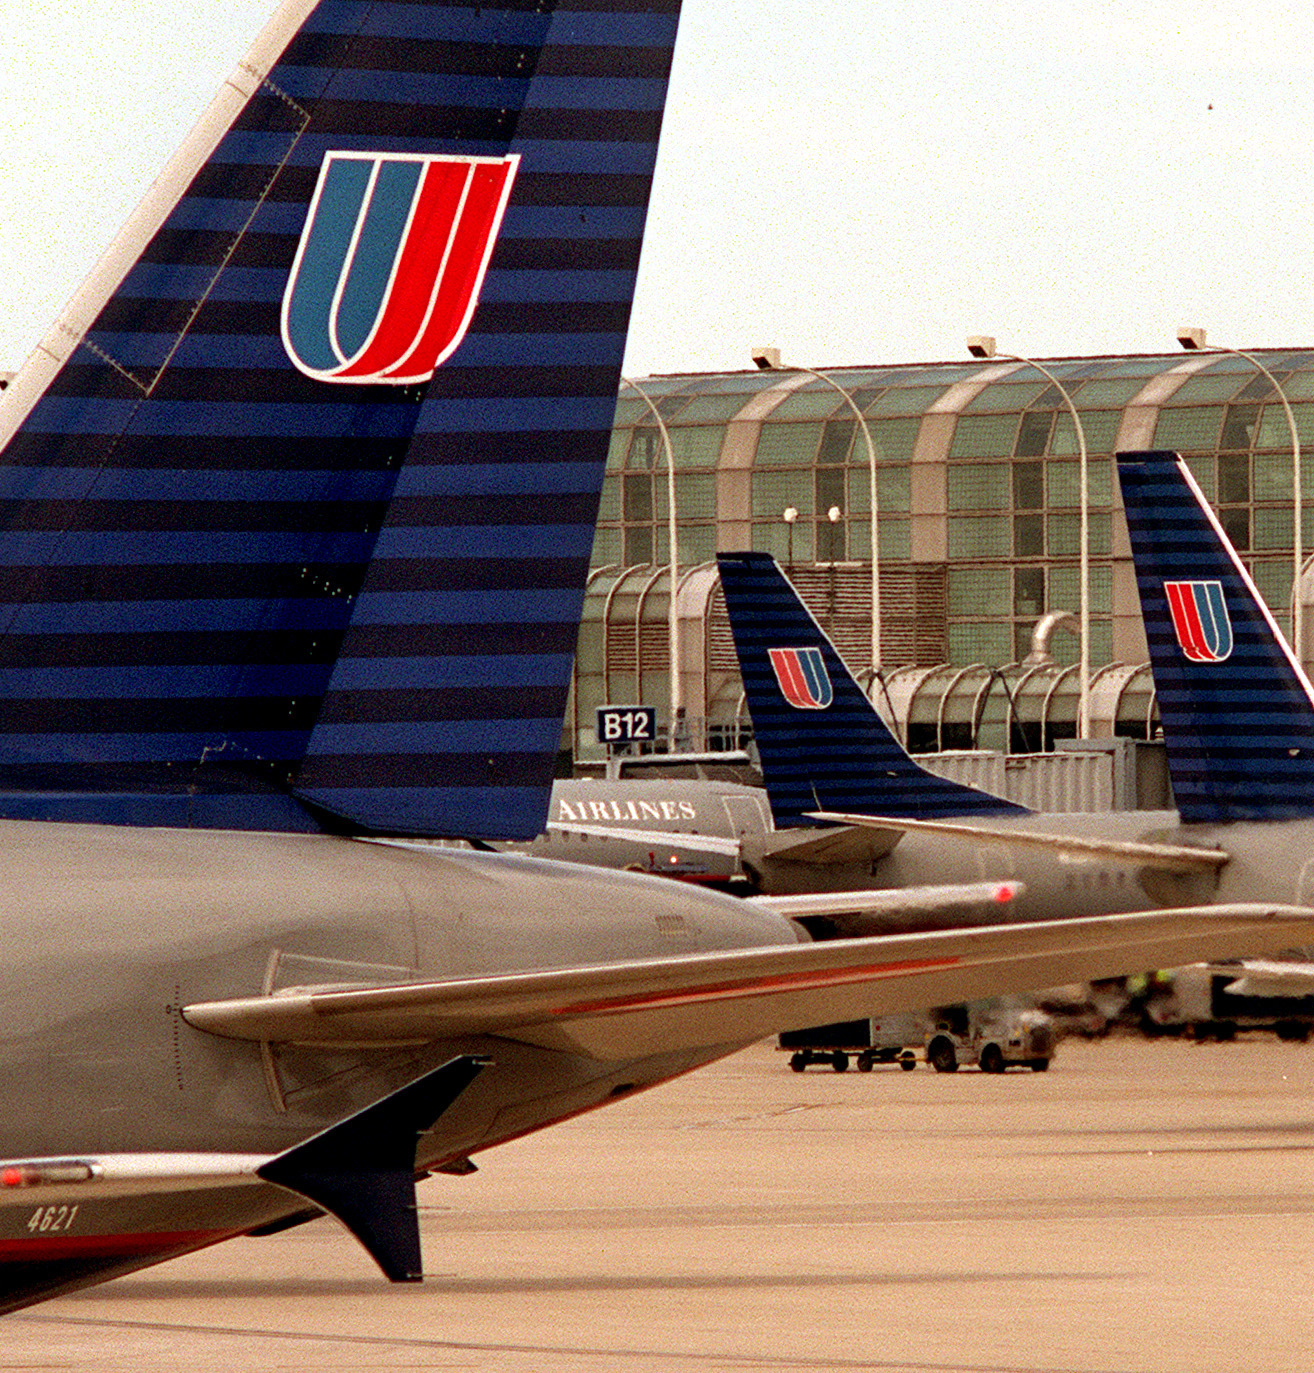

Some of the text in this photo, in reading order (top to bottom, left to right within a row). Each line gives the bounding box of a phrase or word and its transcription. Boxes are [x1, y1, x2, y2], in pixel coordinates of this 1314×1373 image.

[604, 713, 650, 739] B12
[558, 799, 696, 821] AIRLINES
[27, 1204, 80, 1233] 4621
